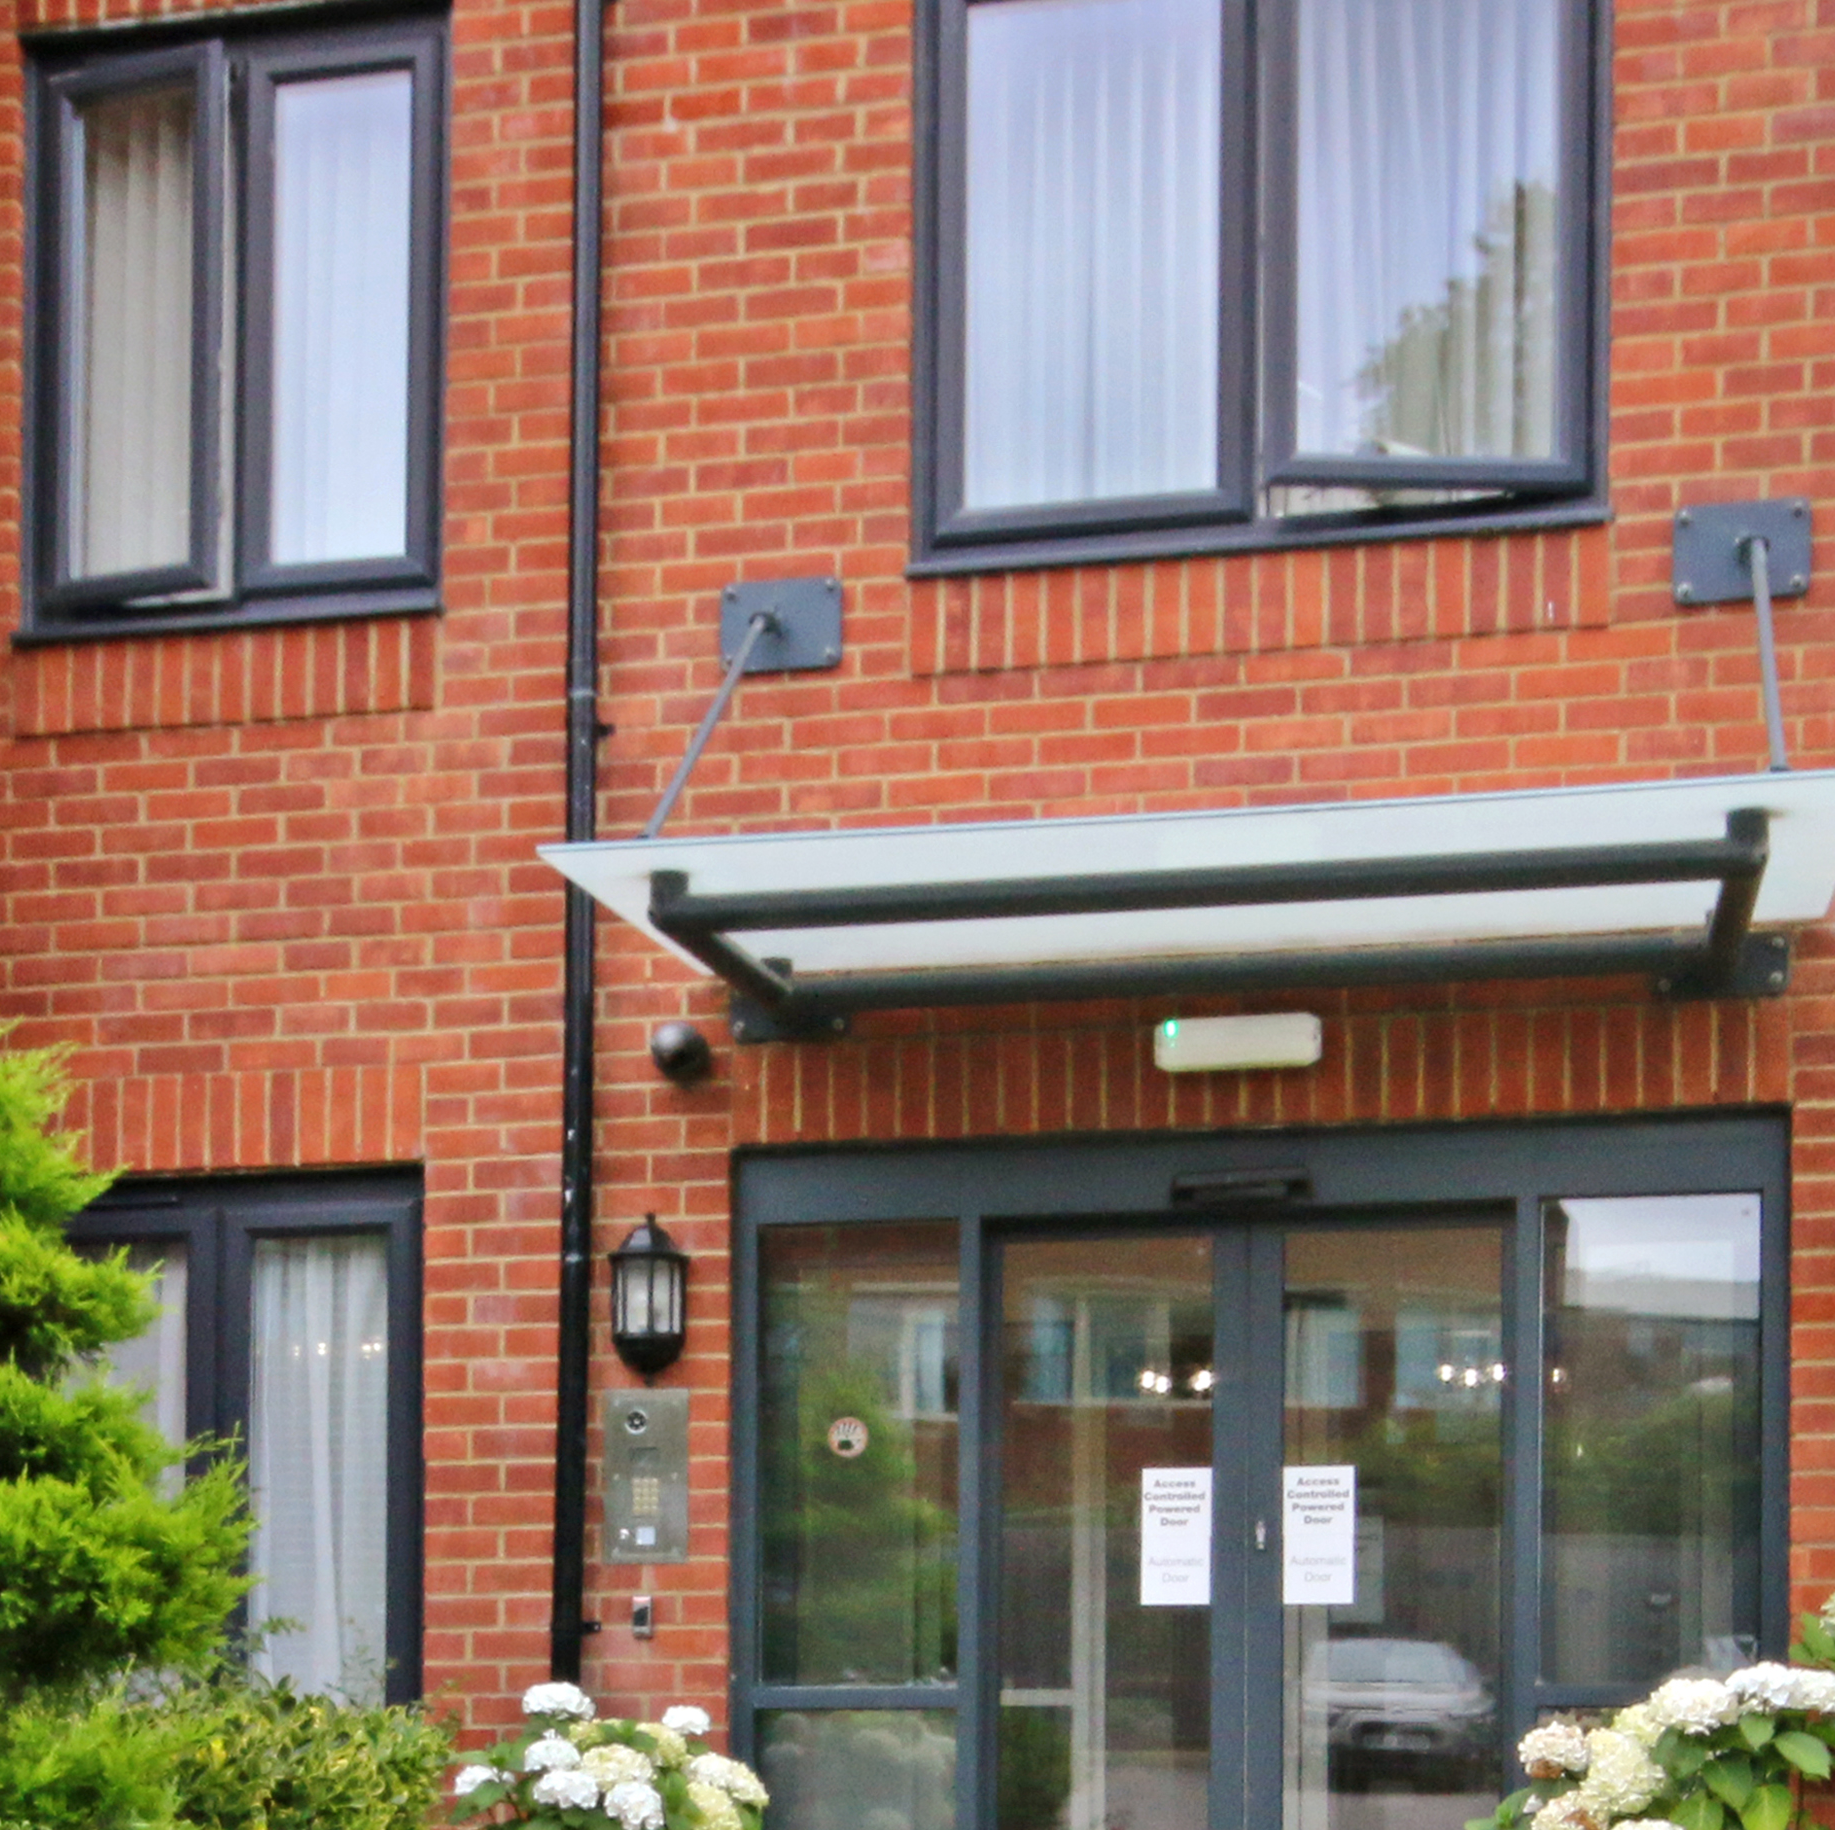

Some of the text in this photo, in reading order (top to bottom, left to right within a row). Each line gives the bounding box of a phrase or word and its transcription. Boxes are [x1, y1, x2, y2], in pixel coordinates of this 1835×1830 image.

[1154, 1479, 1196, 1488] Access
[1297, 1477, 1340, 1487] Access
[1144, 1491, 1206, 1501] Controlled
[1287, 1489, 1350, 1499] Controlled
[1149, 1504, 1200, 1513] Powered
[1292, 1502, 1345, 1511] Powered
[1160, 1517, 1189, 1526] Door
[1304, 1515, 1333, 1525] Door
[1149, 1556, 1204, 1567] Automatic
[1291, 1555, 1347, 1566] Automatic
[1161, 1572, 1191, 1583] Door
[1303, 1571, 1333, 1582] Door
